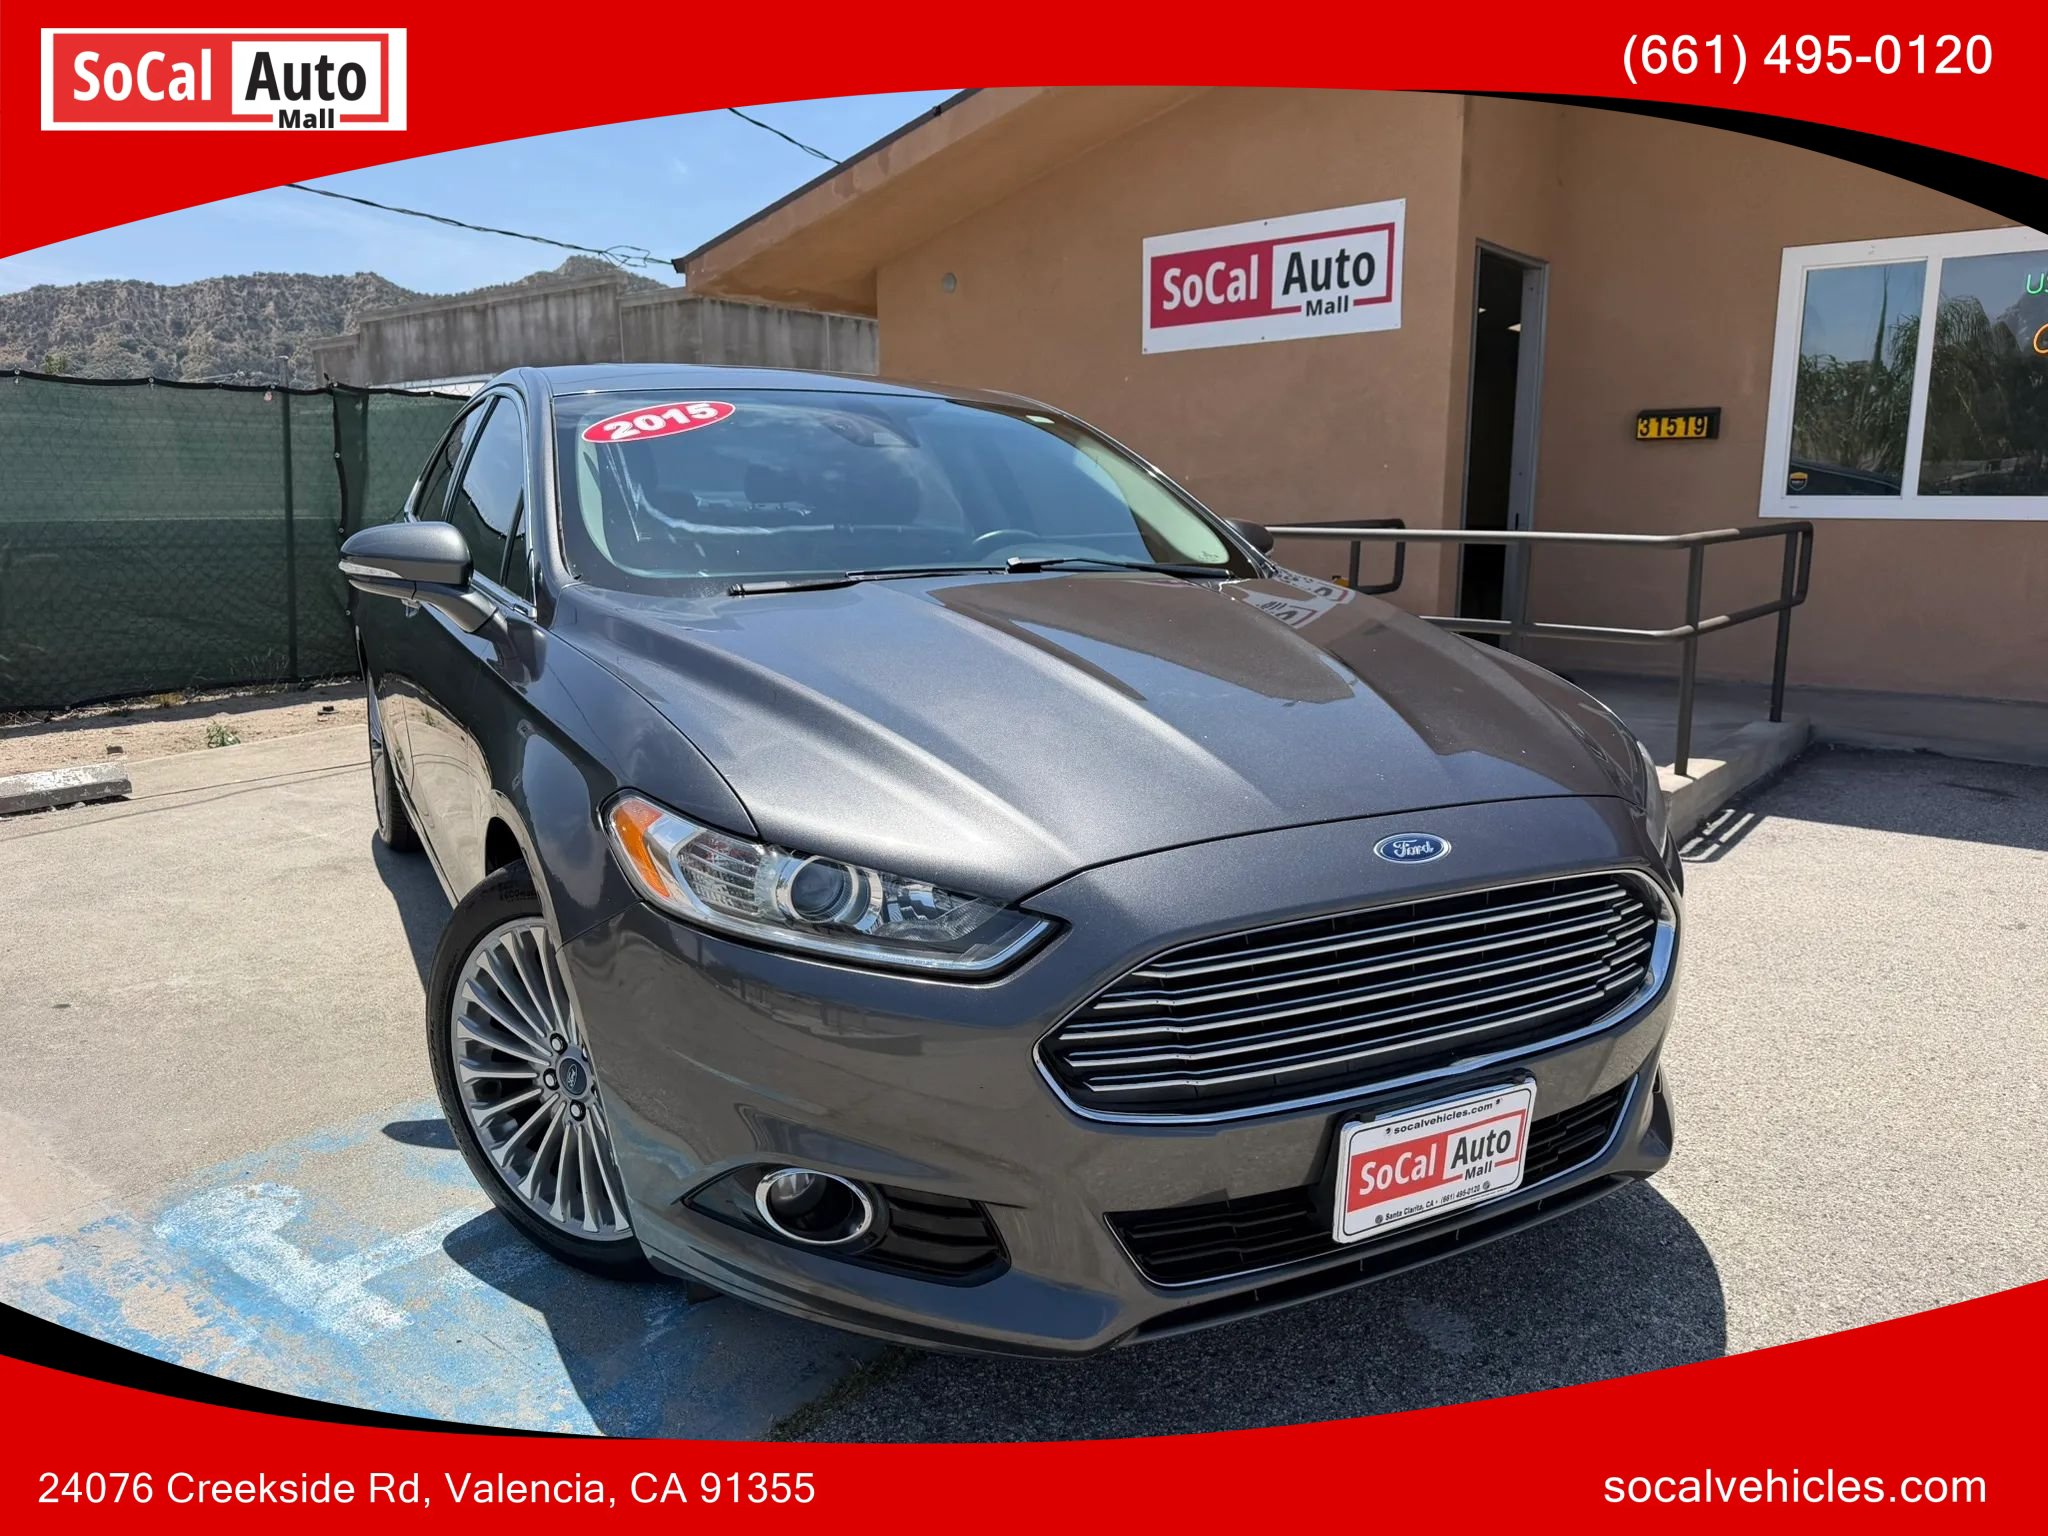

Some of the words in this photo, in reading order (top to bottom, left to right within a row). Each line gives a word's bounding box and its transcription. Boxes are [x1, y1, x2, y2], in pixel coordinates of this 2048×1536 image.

[1162, 254, 1259, 311] SoCal
[1282, 248, 1376, 295] Auto
[1305, 295, 1349, 317] Mall
[603, 402, 719, 440] 2015
[1639, 416, 1705, 437] 31519
[1392, 839, 1435, 858] Ford
[1393, 1102, 1493, 1135] socalvehicles.com
[1359, 1143, 1437, 1196] SoCal
[1450, 1128, 1511, 1170] Auto
[1464, 1160, 1493, 1181] Mall
